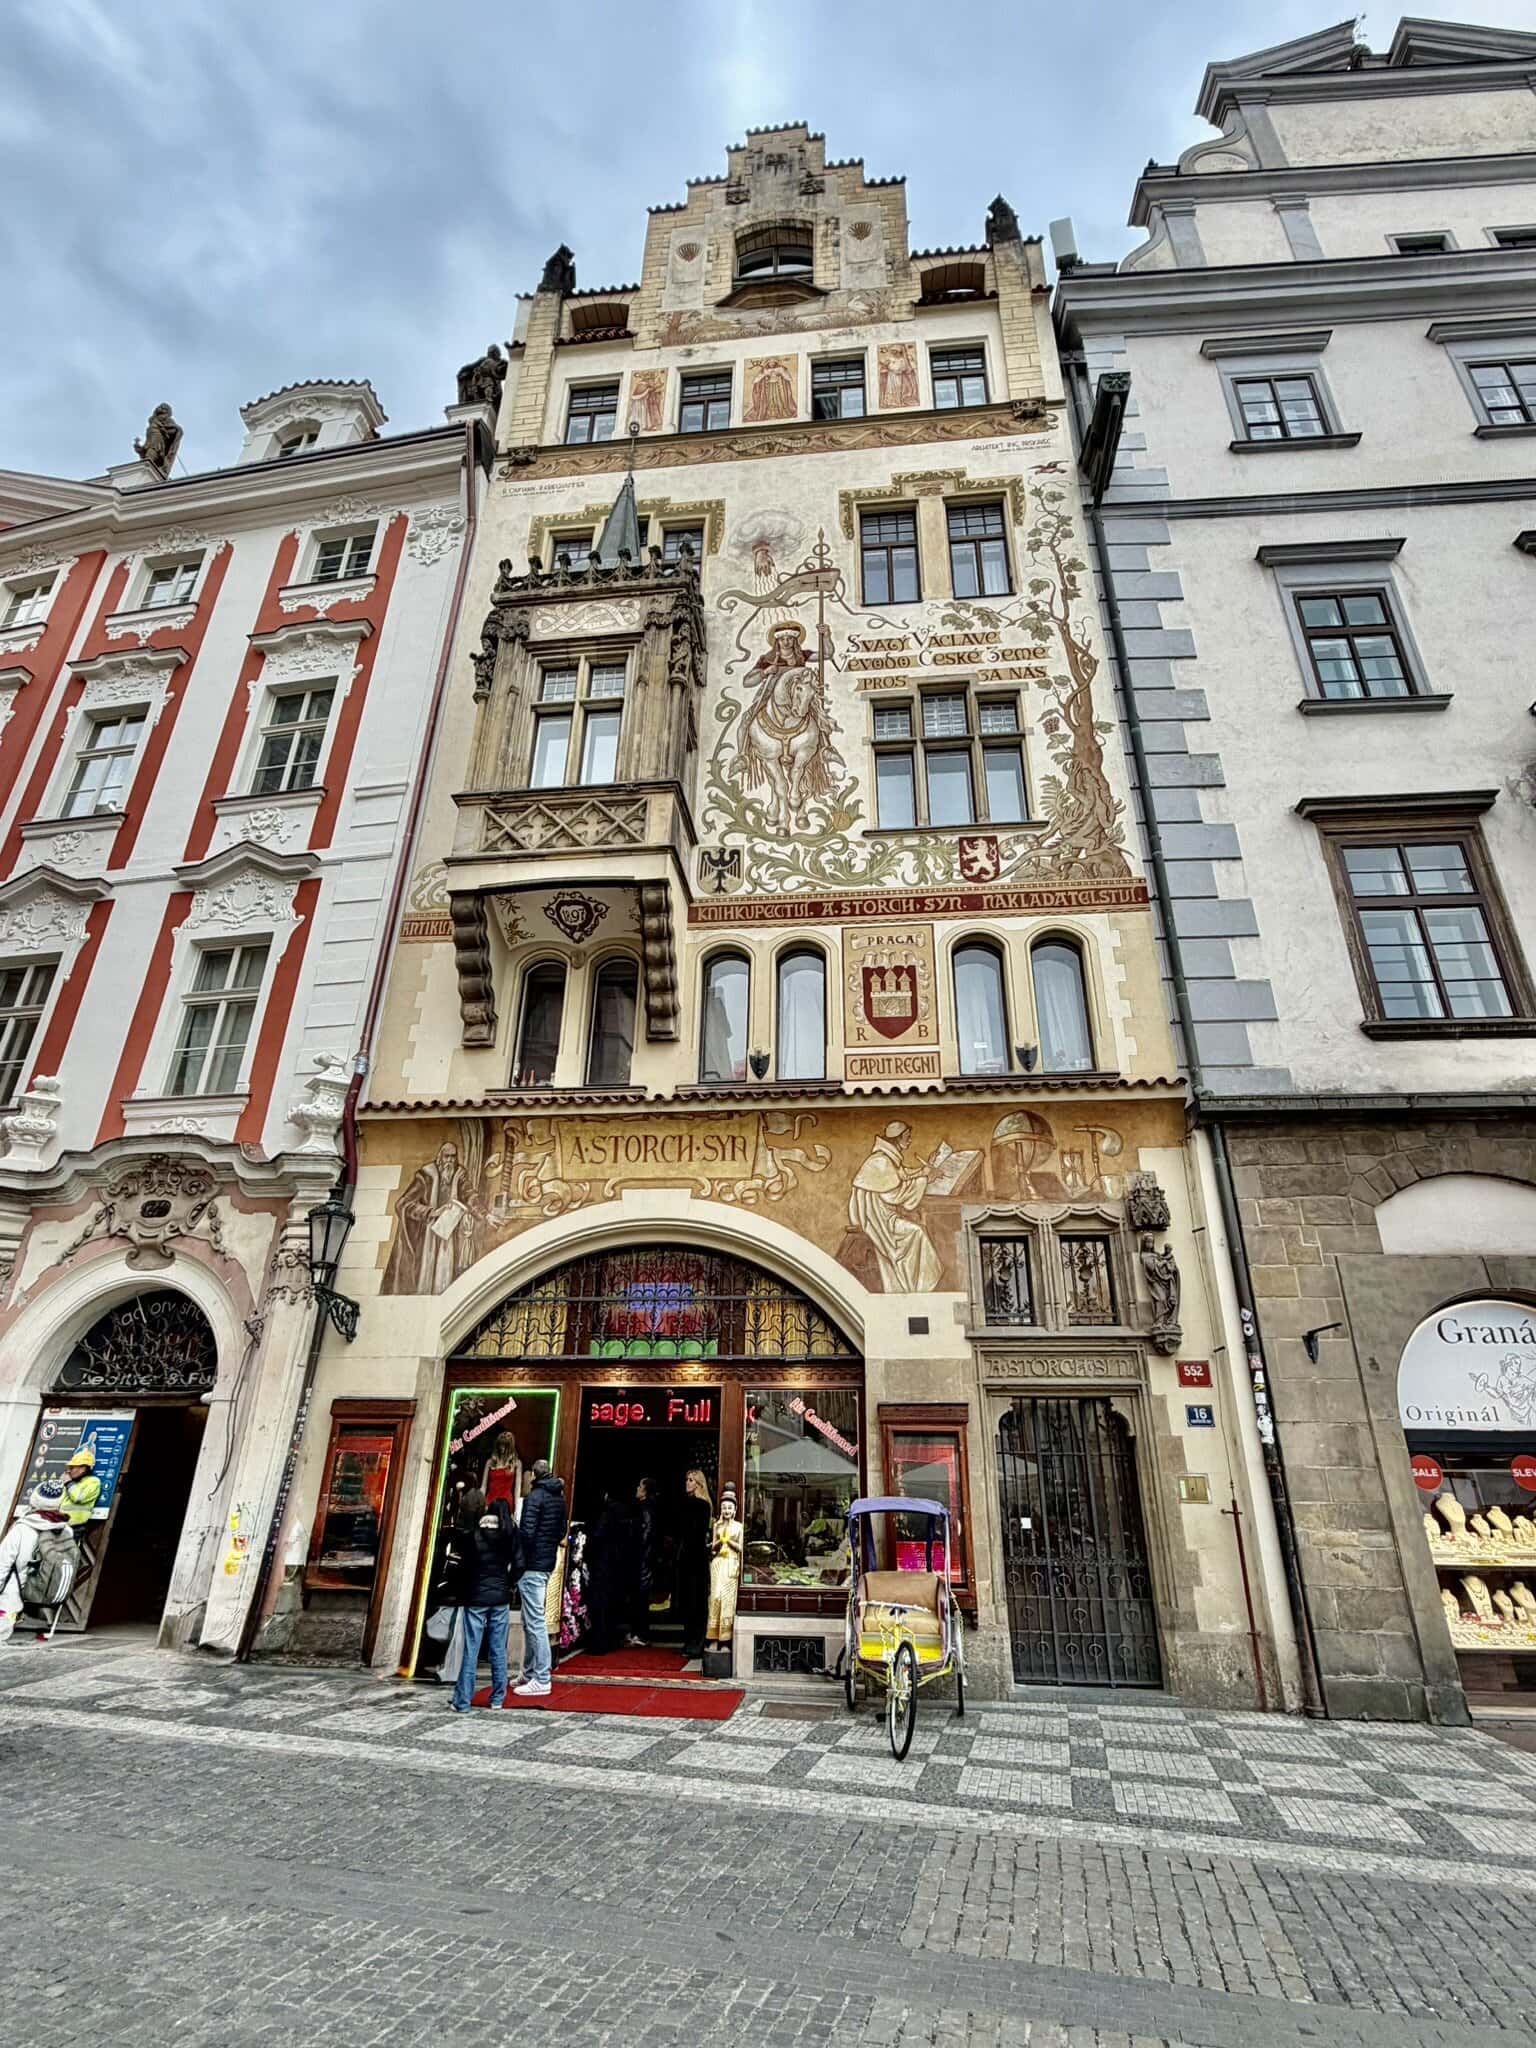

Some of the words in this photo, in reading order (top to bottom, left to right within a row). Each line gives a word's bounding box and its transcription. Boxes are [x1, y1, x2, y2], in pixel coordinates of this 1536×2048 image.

[863, 676, 906, 689] PROS
[1009, 665, 1047, 679] NÁS
[856, 1027, 868, 1041] R
[918, 1025, 928, 1038] B
[1184, 1365, 1204, 1377] 552
[463, 1397, 517, 1442] Conditioned
[591, 1402, 651, 1426] sage.
[667, 1399, 711, 1422] Full
[1193, 1407, 1207, 1419] 16
[1406, 1405, 1500, 1425] Originál
[804, 1408, 858, 1456] Conditioned
[1412, 1468, 1439, 1477] SALE
